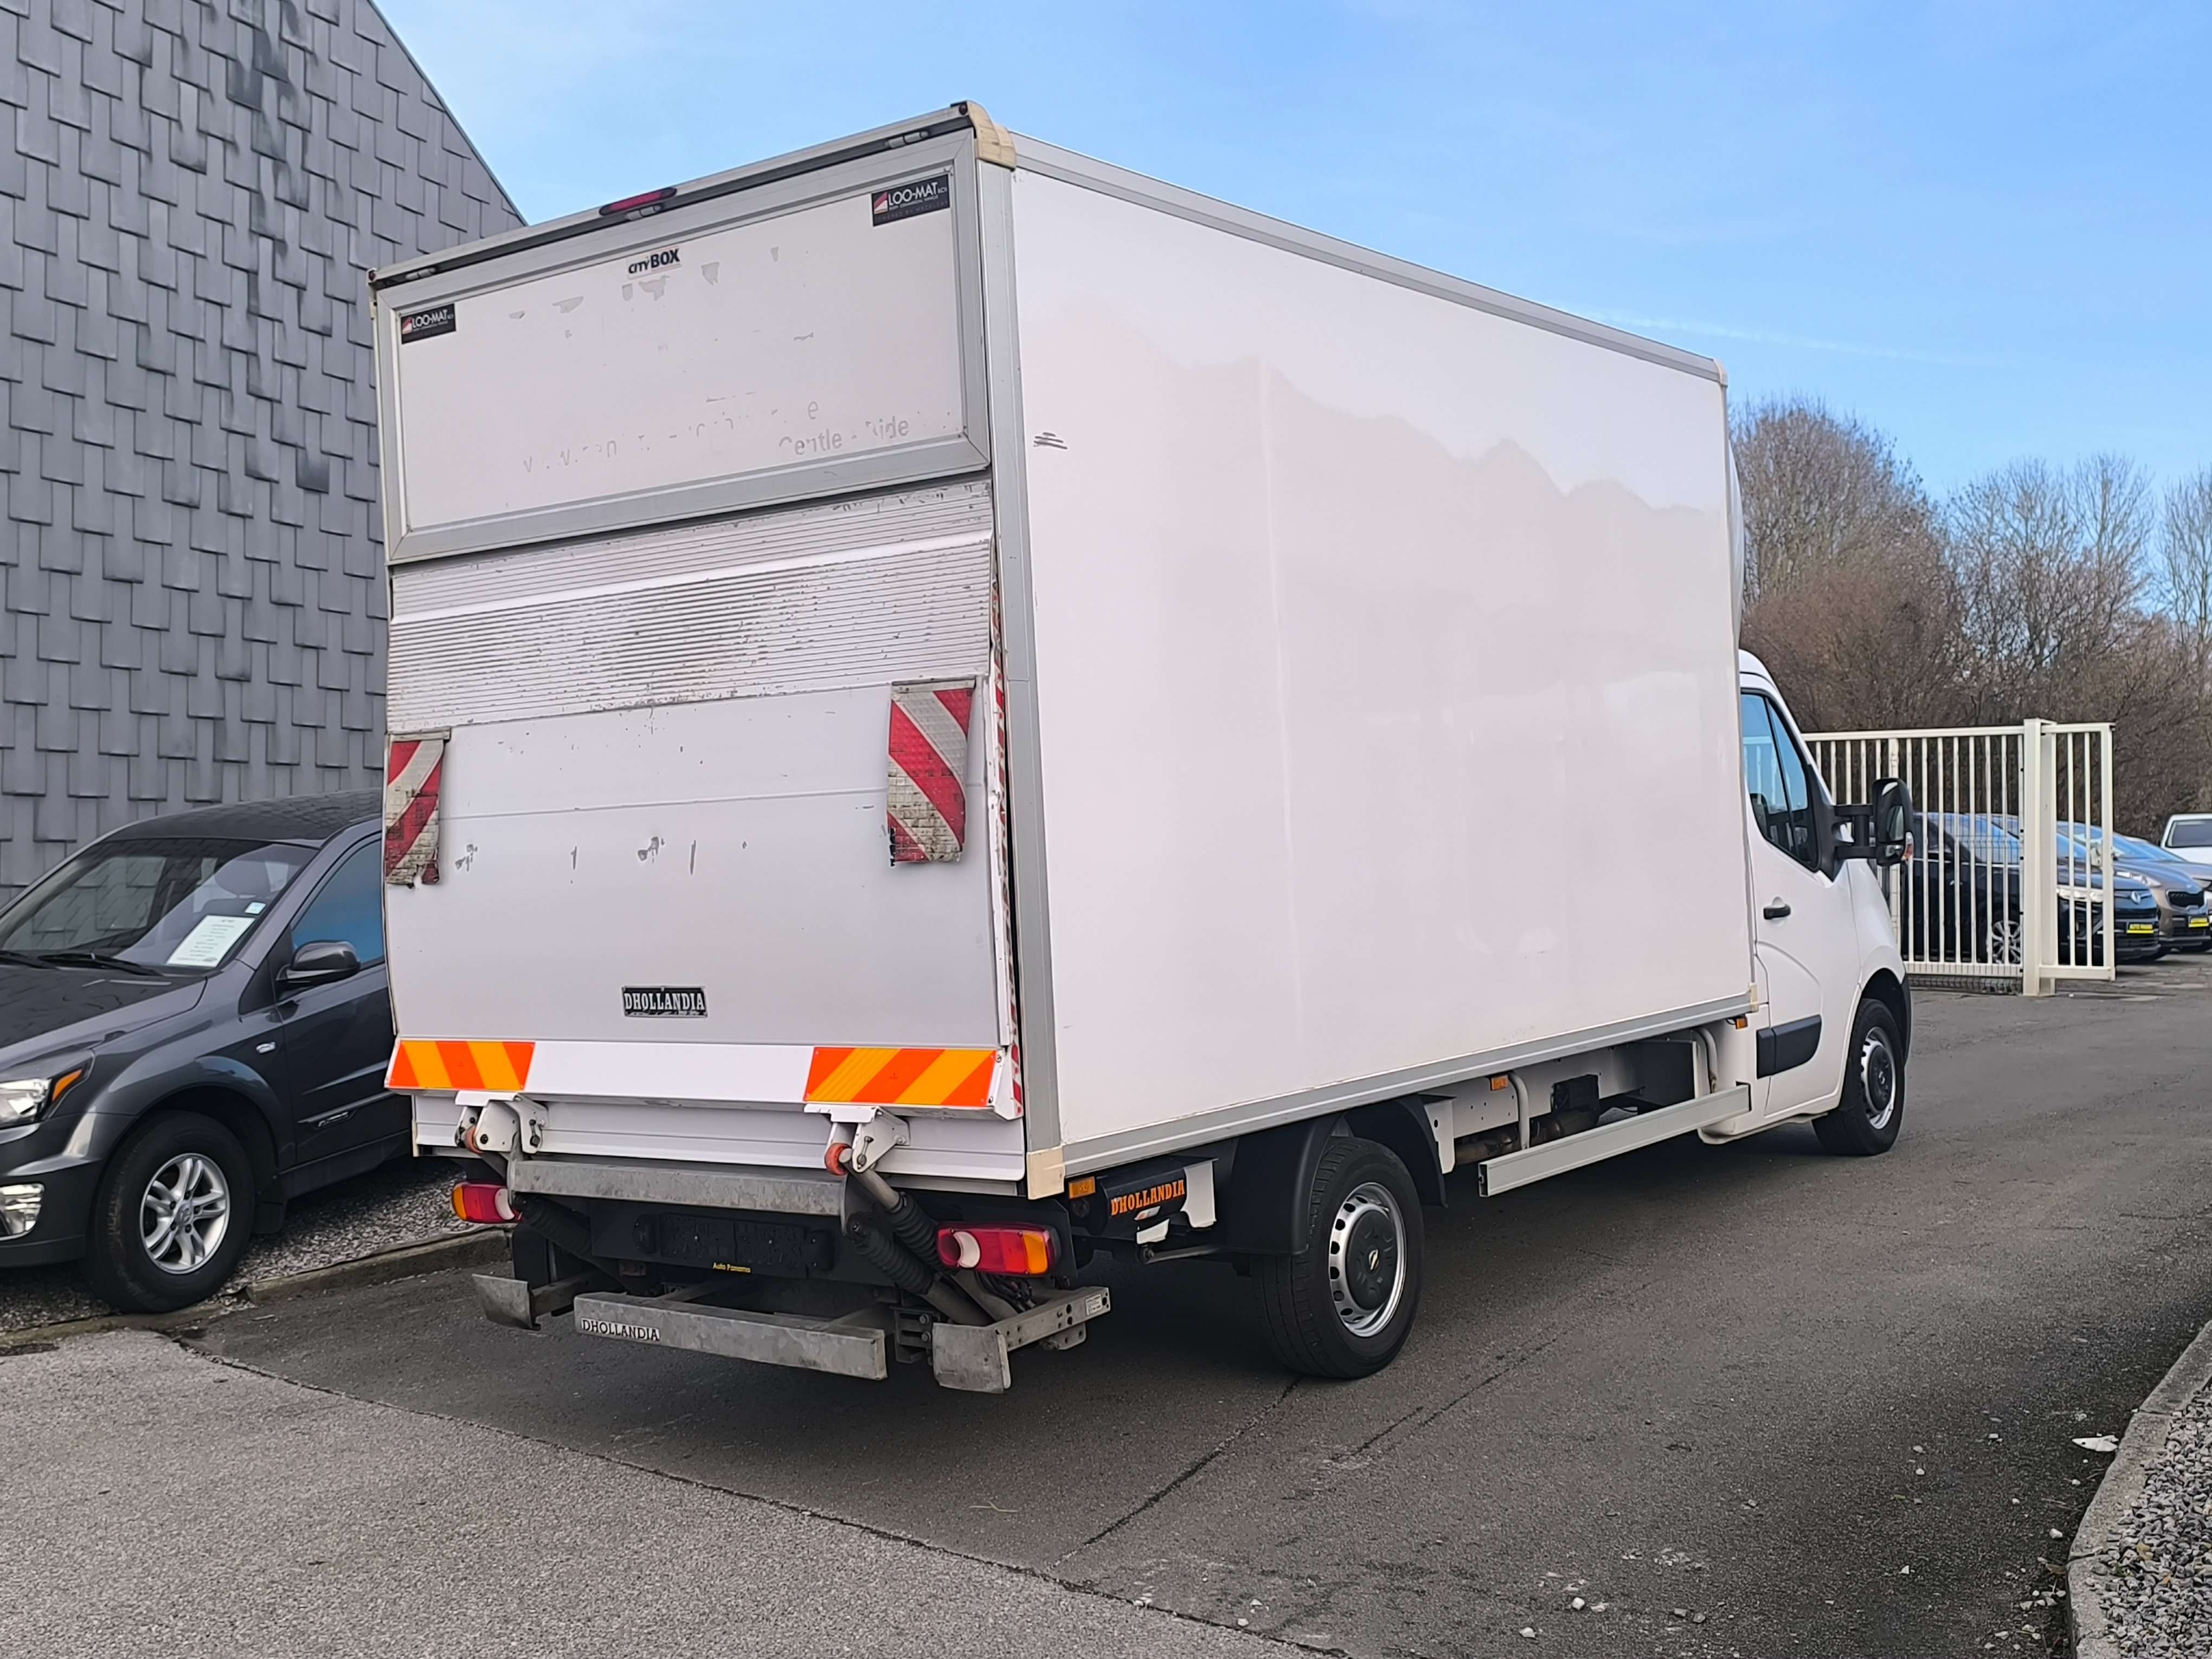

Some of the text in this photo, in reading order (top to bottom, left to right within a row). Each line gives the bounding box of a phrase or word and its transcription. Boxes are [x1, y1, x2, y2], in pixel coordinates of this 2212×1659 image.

[888, 182, 938, 205] LOO-MAT
[412, 309, 448, 328] LOO-MAT
[624, 993, 705, 1011] DHOLLANDIA
[582, 1319, 660, 1342] DHOLLANDIA
